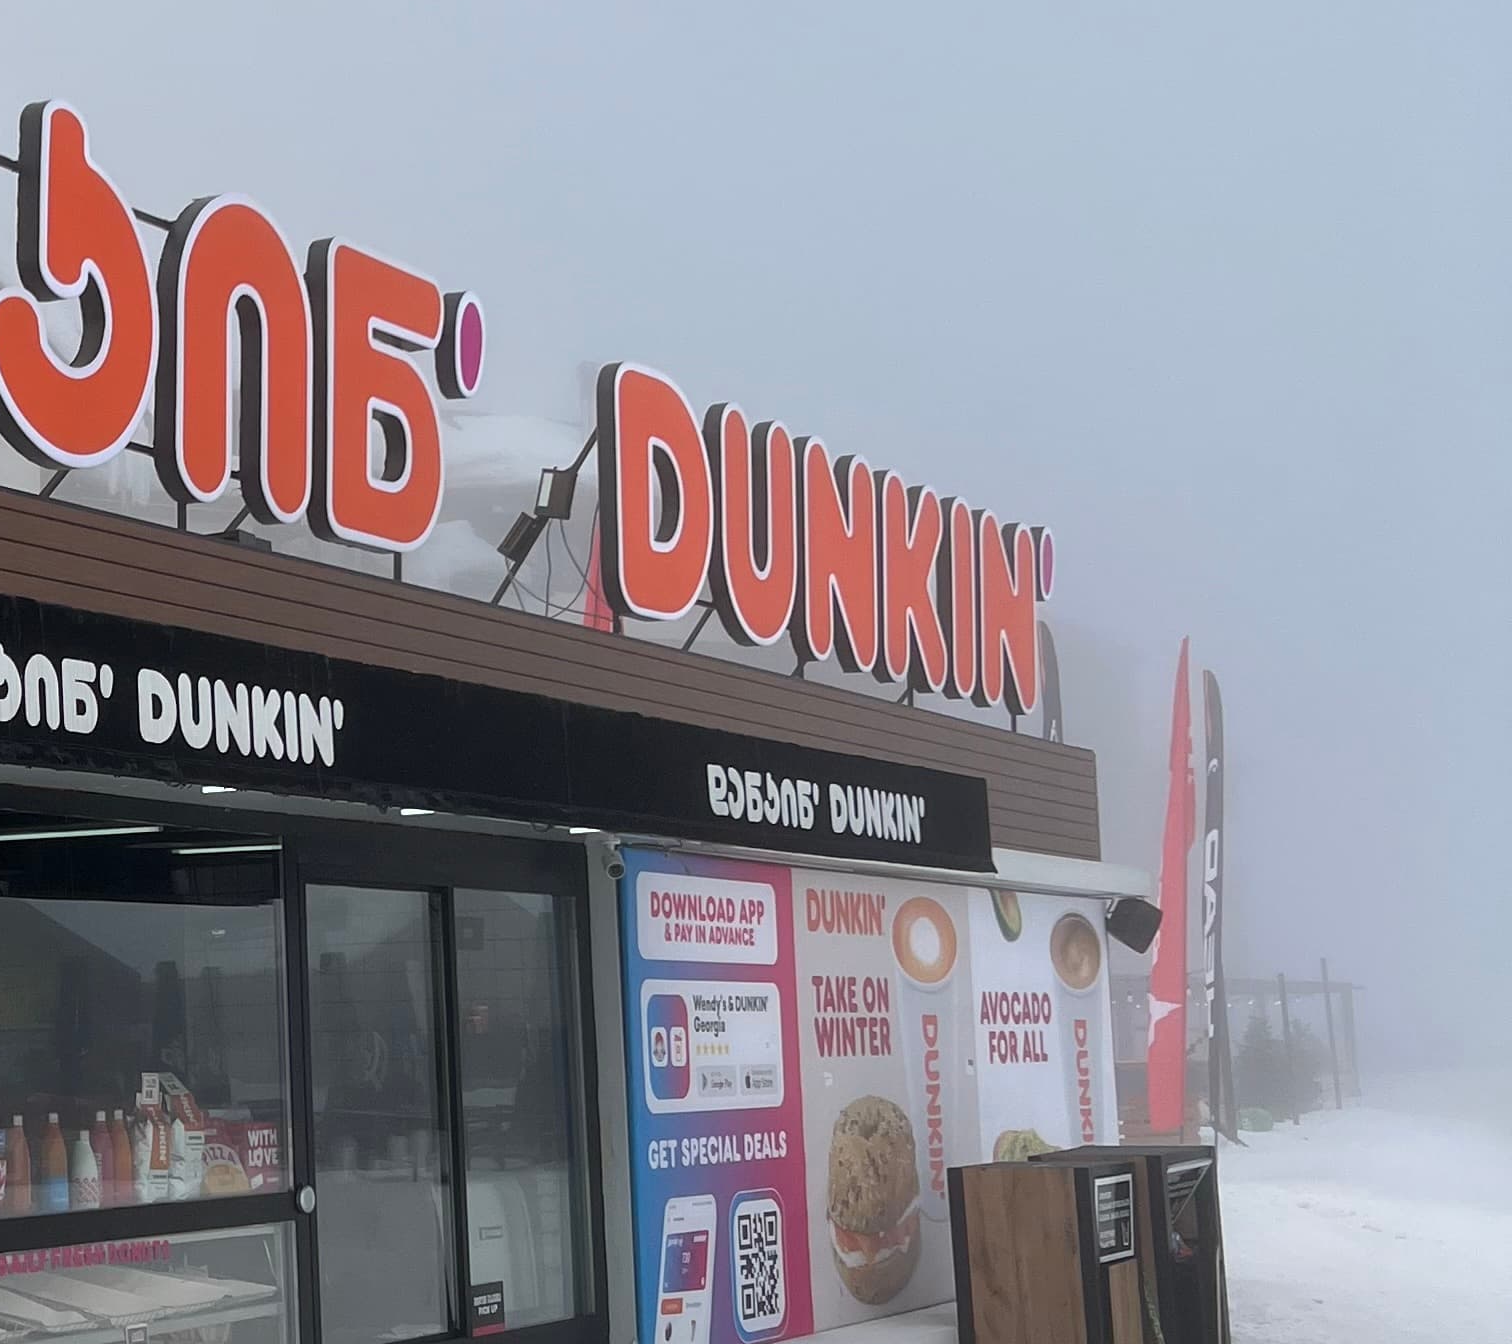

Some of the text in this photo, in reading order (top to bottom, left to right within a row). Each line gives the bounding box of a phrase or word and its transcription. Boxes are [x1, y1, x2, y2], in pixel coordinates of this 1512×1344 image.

[597, 360, 1055, 715] DUNKIN'
[137, 668, 344, 767] DUNKIN'
[830, 785, 925, 844] DUNKIN'
[650, 891, 765, 925] DOWNLOAD APP
[806, 888, 886, 936] DUNKIN'
[664, 922, 755, 946] & PAY IN ADVANCE
[692, 994, 727, 1017] Wendy's
[812, 976, 889, 1013] TAKE ON
[980, 991, 1052, 1025] AVOCADO
[693, 1016, 726, 1038] Georgia
[814, 1017, 891, 1057] WINTER
[989, 1030, 1049, 1064] FOR ALL
[921, 1014, 945, 1200] DUNKIN'
[248, 1129, 278, 1147] WITH
[648, 1130, 787, 1169] GET SPECIAL DEALS
